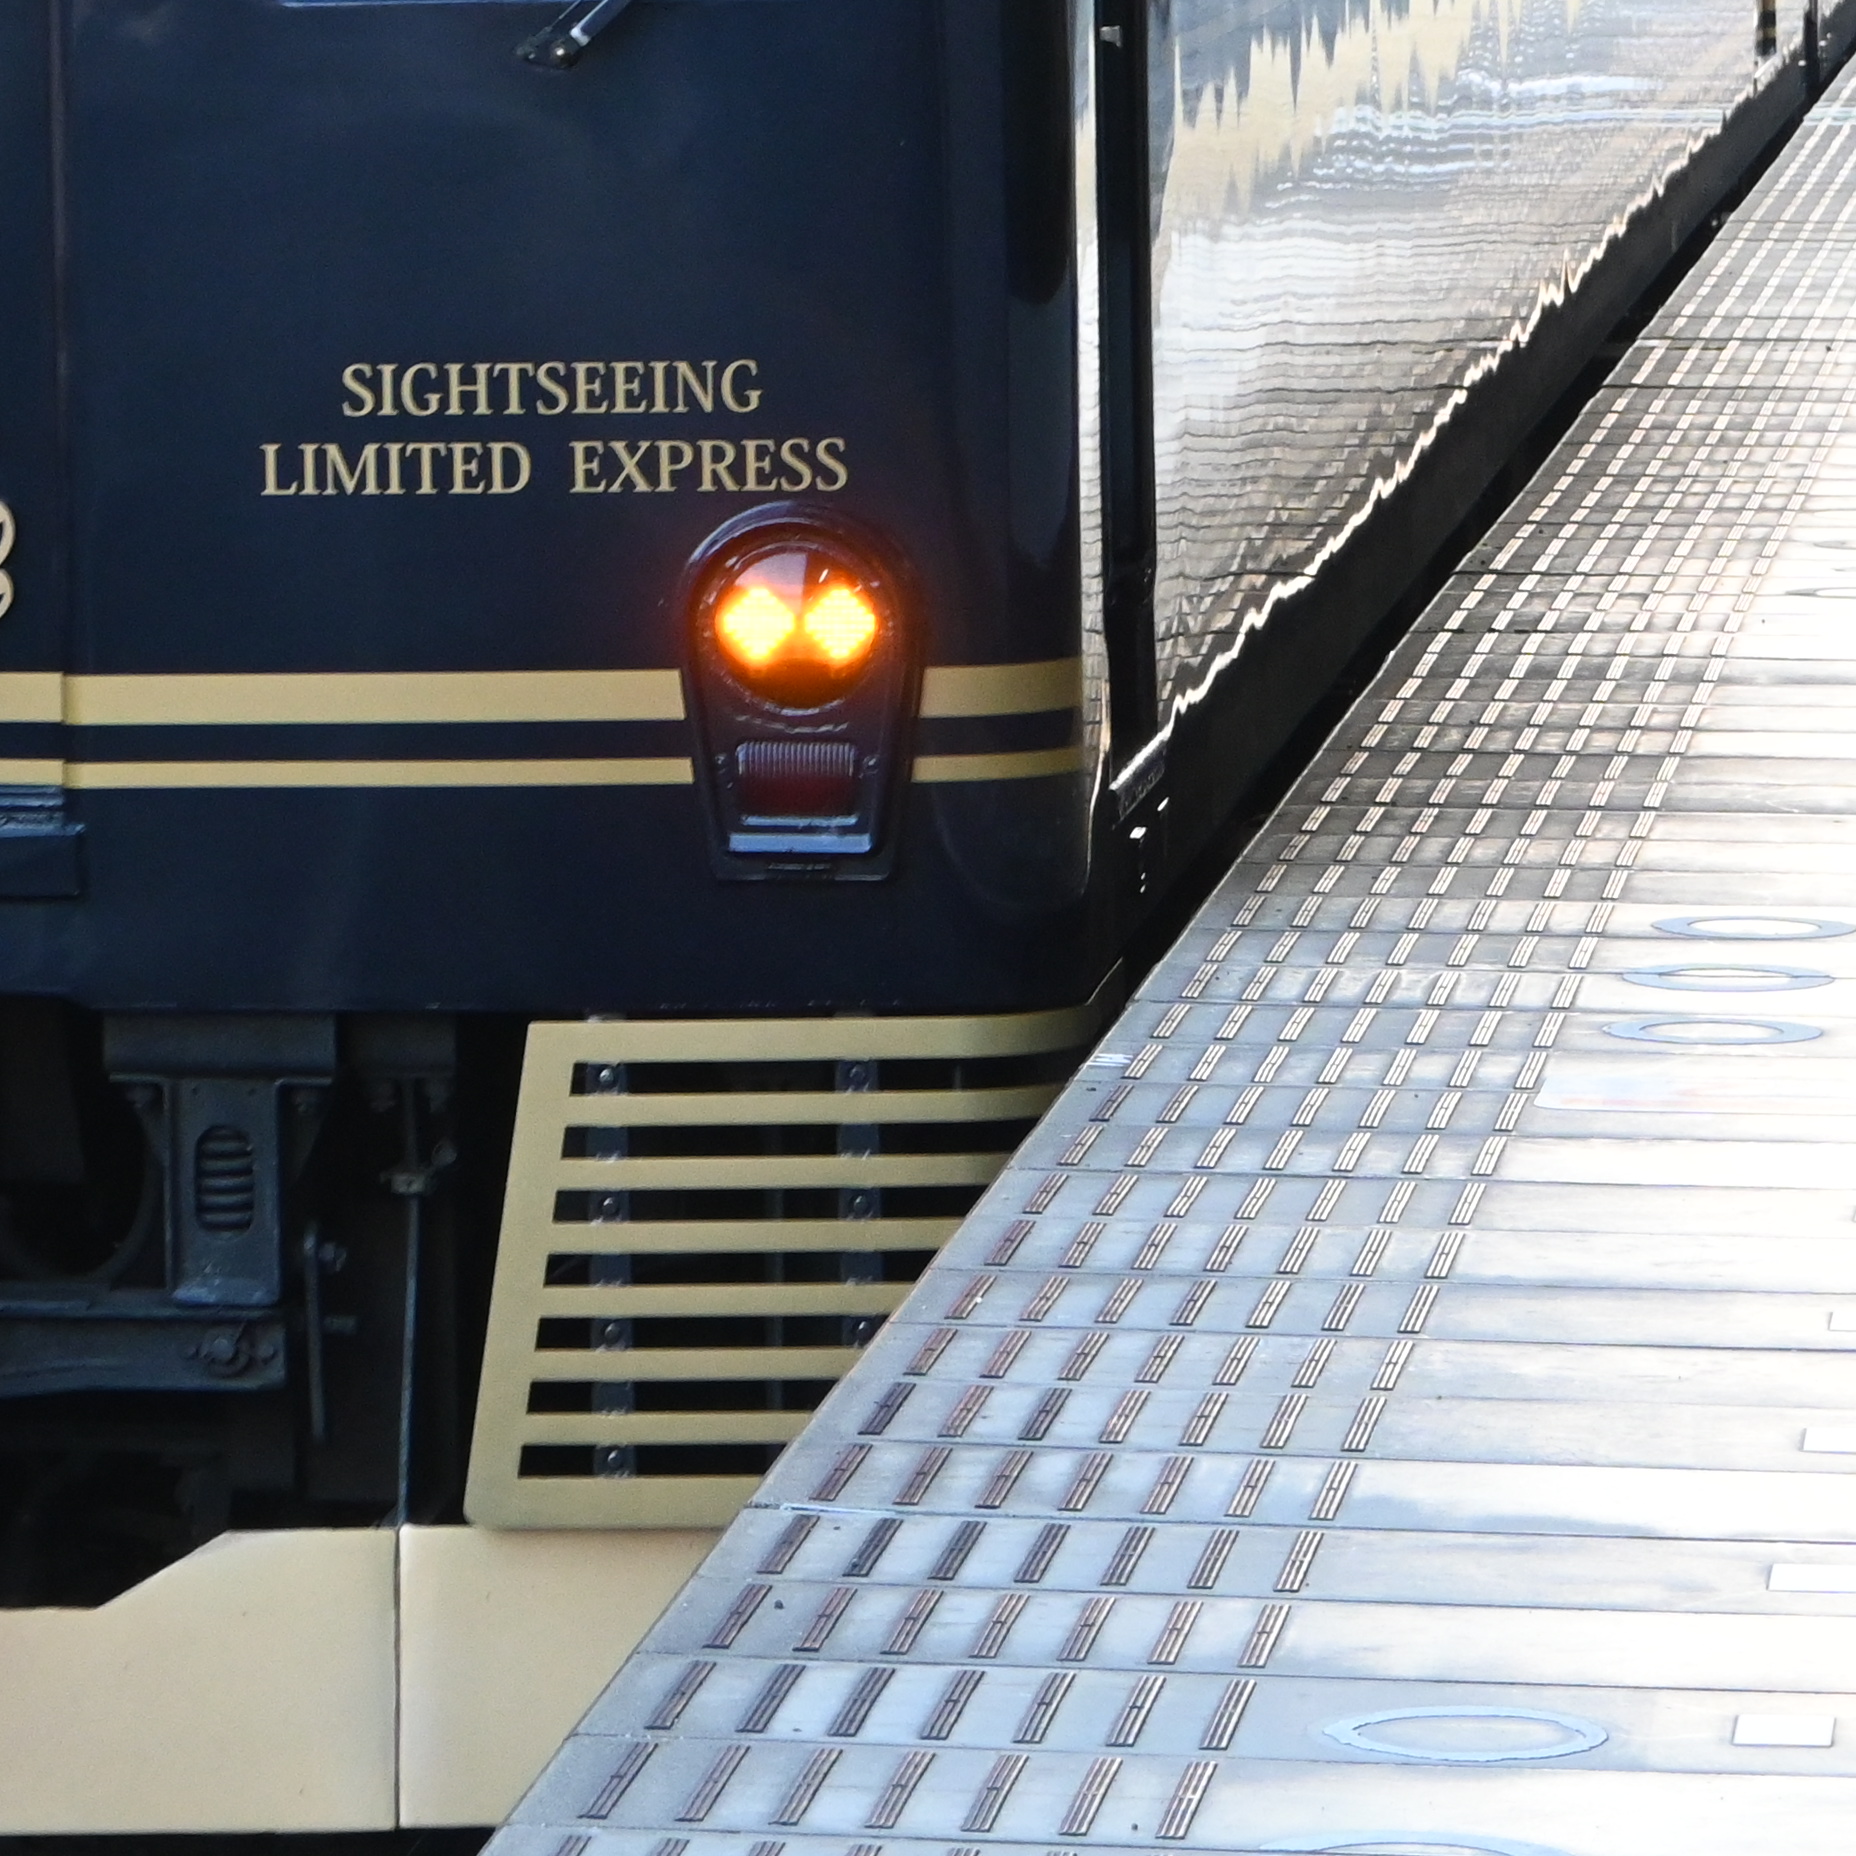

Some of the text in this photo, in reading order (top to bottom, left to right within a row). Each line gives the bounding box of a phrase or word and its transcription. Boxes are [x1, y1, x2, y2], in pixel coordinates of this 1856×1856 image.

[341, 358, 764, 418] SIGHTSEEING
[259, 437, 848, 496] LIMITED EXPRESS
